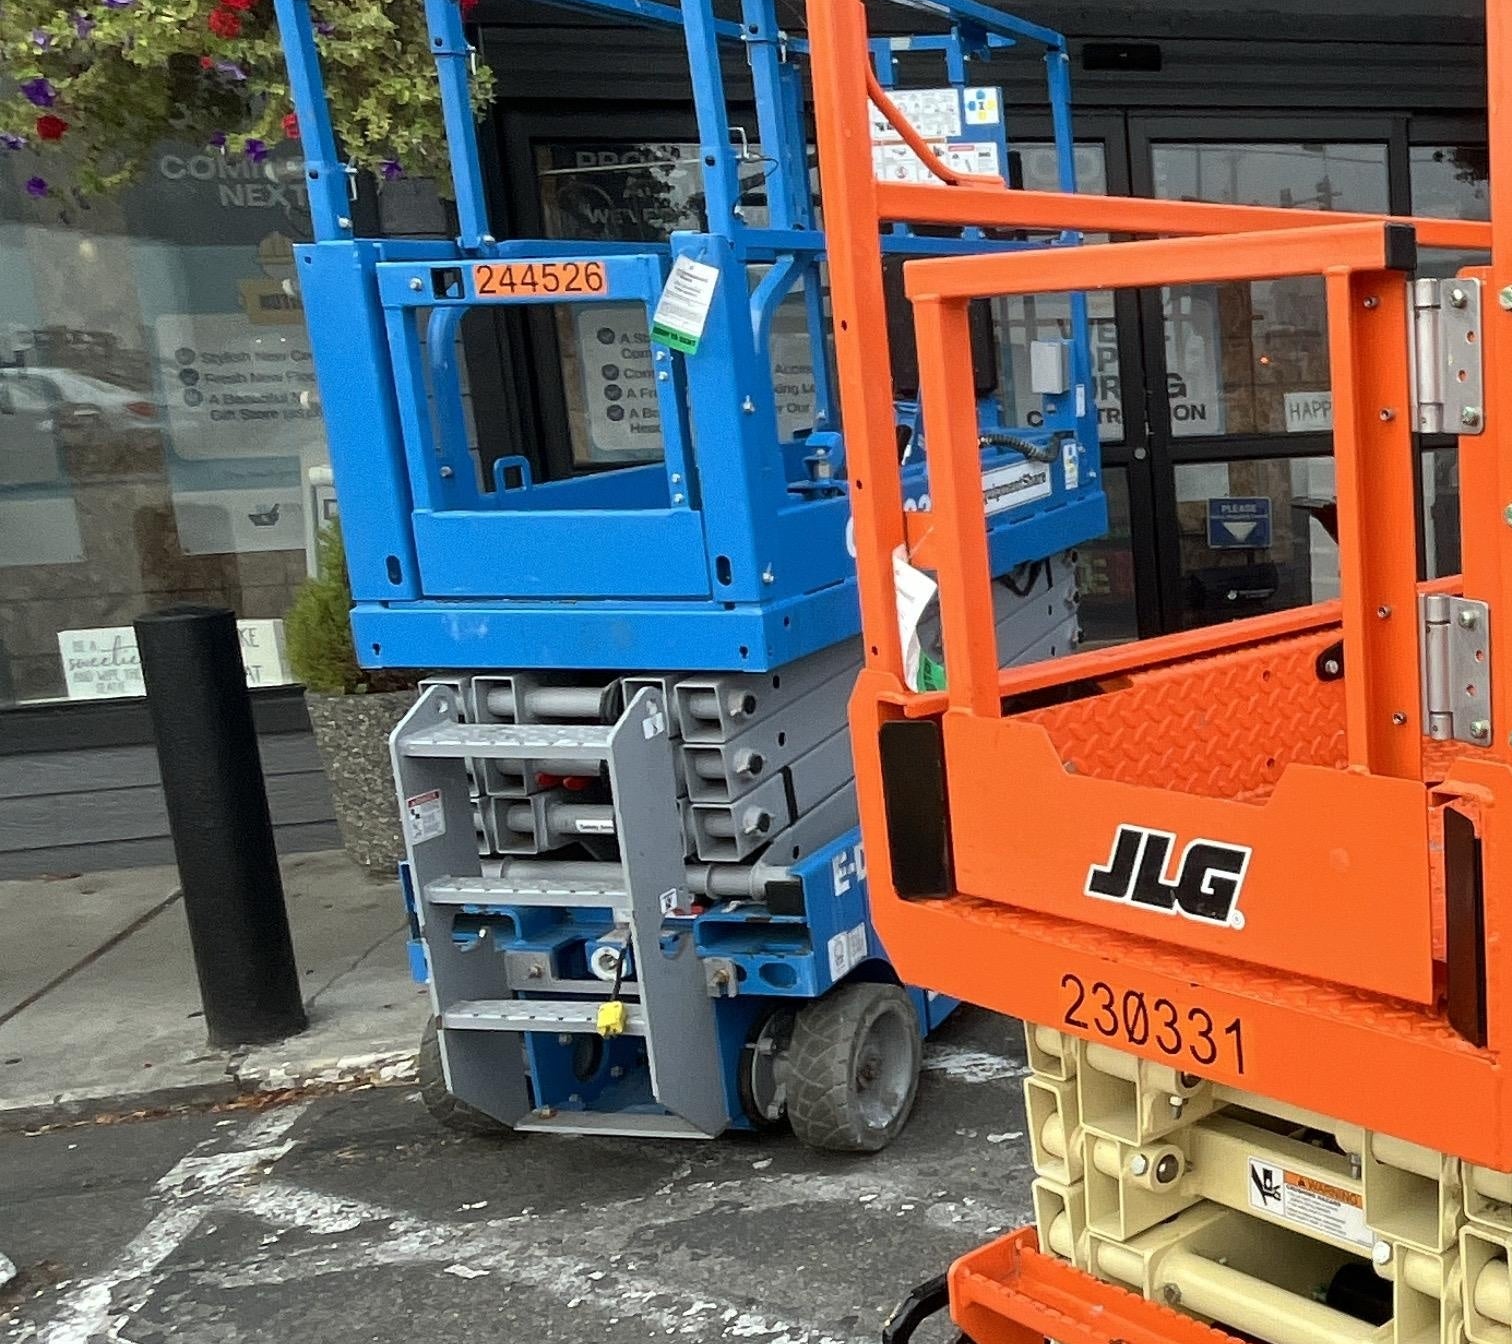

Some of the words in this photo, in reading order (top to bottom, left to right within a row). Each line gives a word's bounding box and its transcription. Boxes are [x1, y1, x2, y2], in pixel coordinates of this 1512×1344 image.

[476, 261, 604, 295] 244526
[1087, 826, 1250, 924] JLG
[1061, 973, 1244, 1076] 230331
